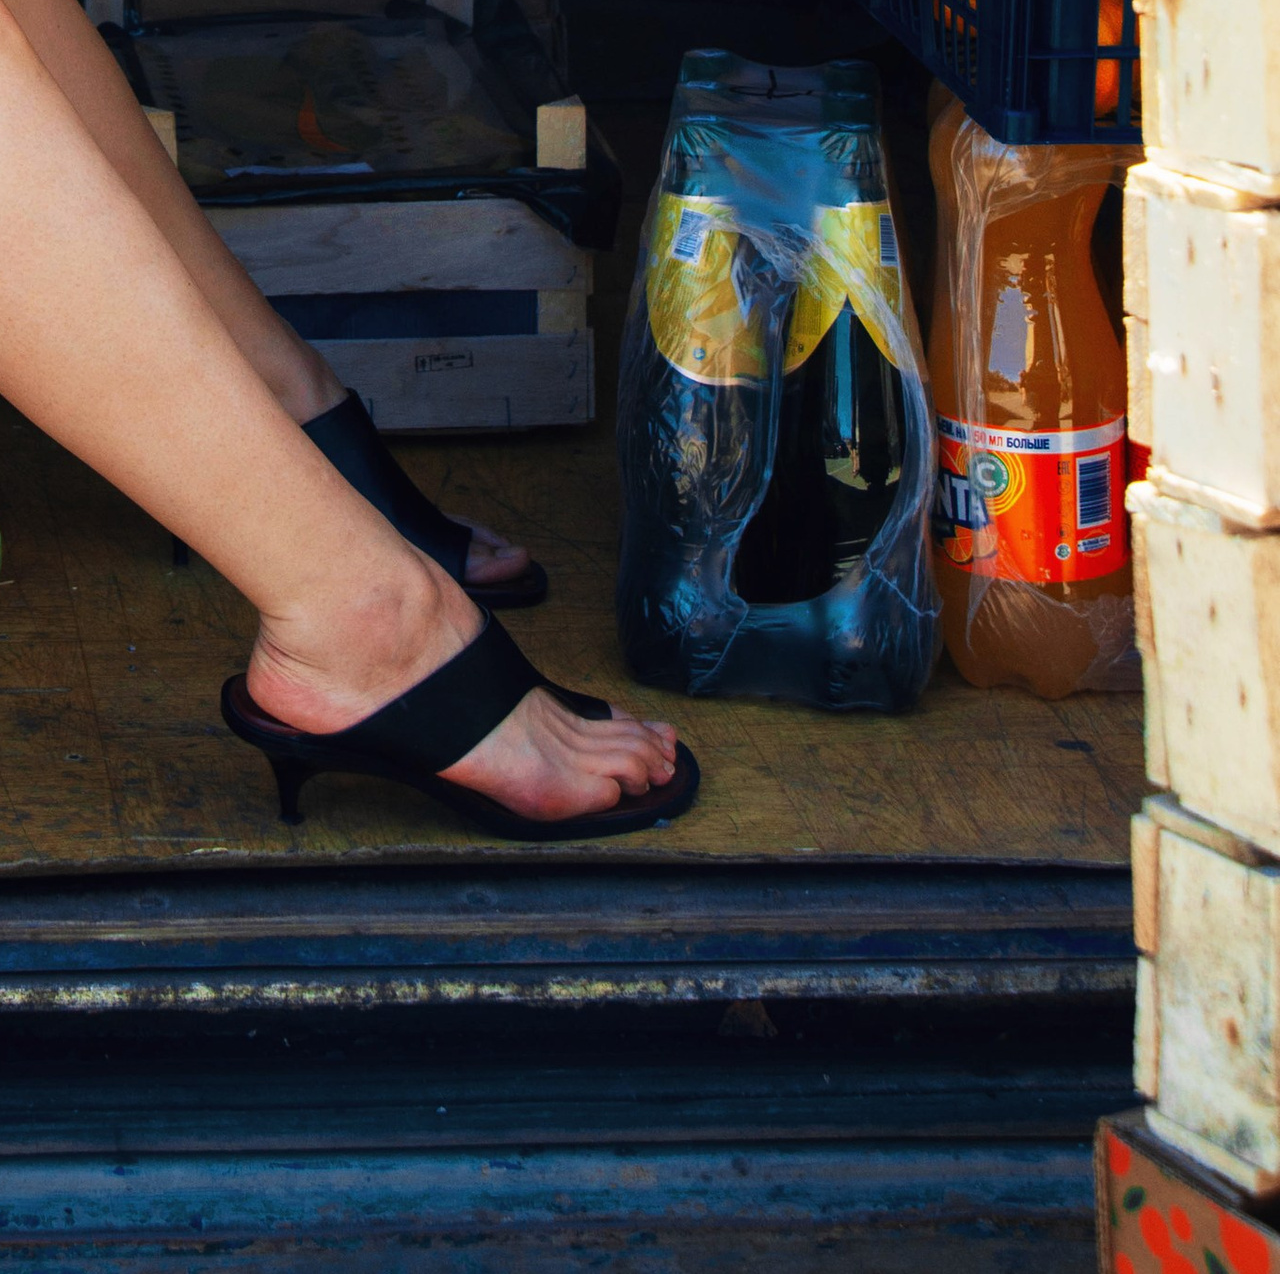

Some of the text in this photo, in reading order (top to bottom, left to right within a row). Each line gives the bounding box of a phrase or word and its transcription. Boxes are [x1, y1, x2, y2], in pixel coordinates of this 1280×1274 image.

[989, 435, 1003, 447] МЛ
[1006, 437, 1050, 450] БОЛЬШЕ
[937, 473, 987, 523] NTA
